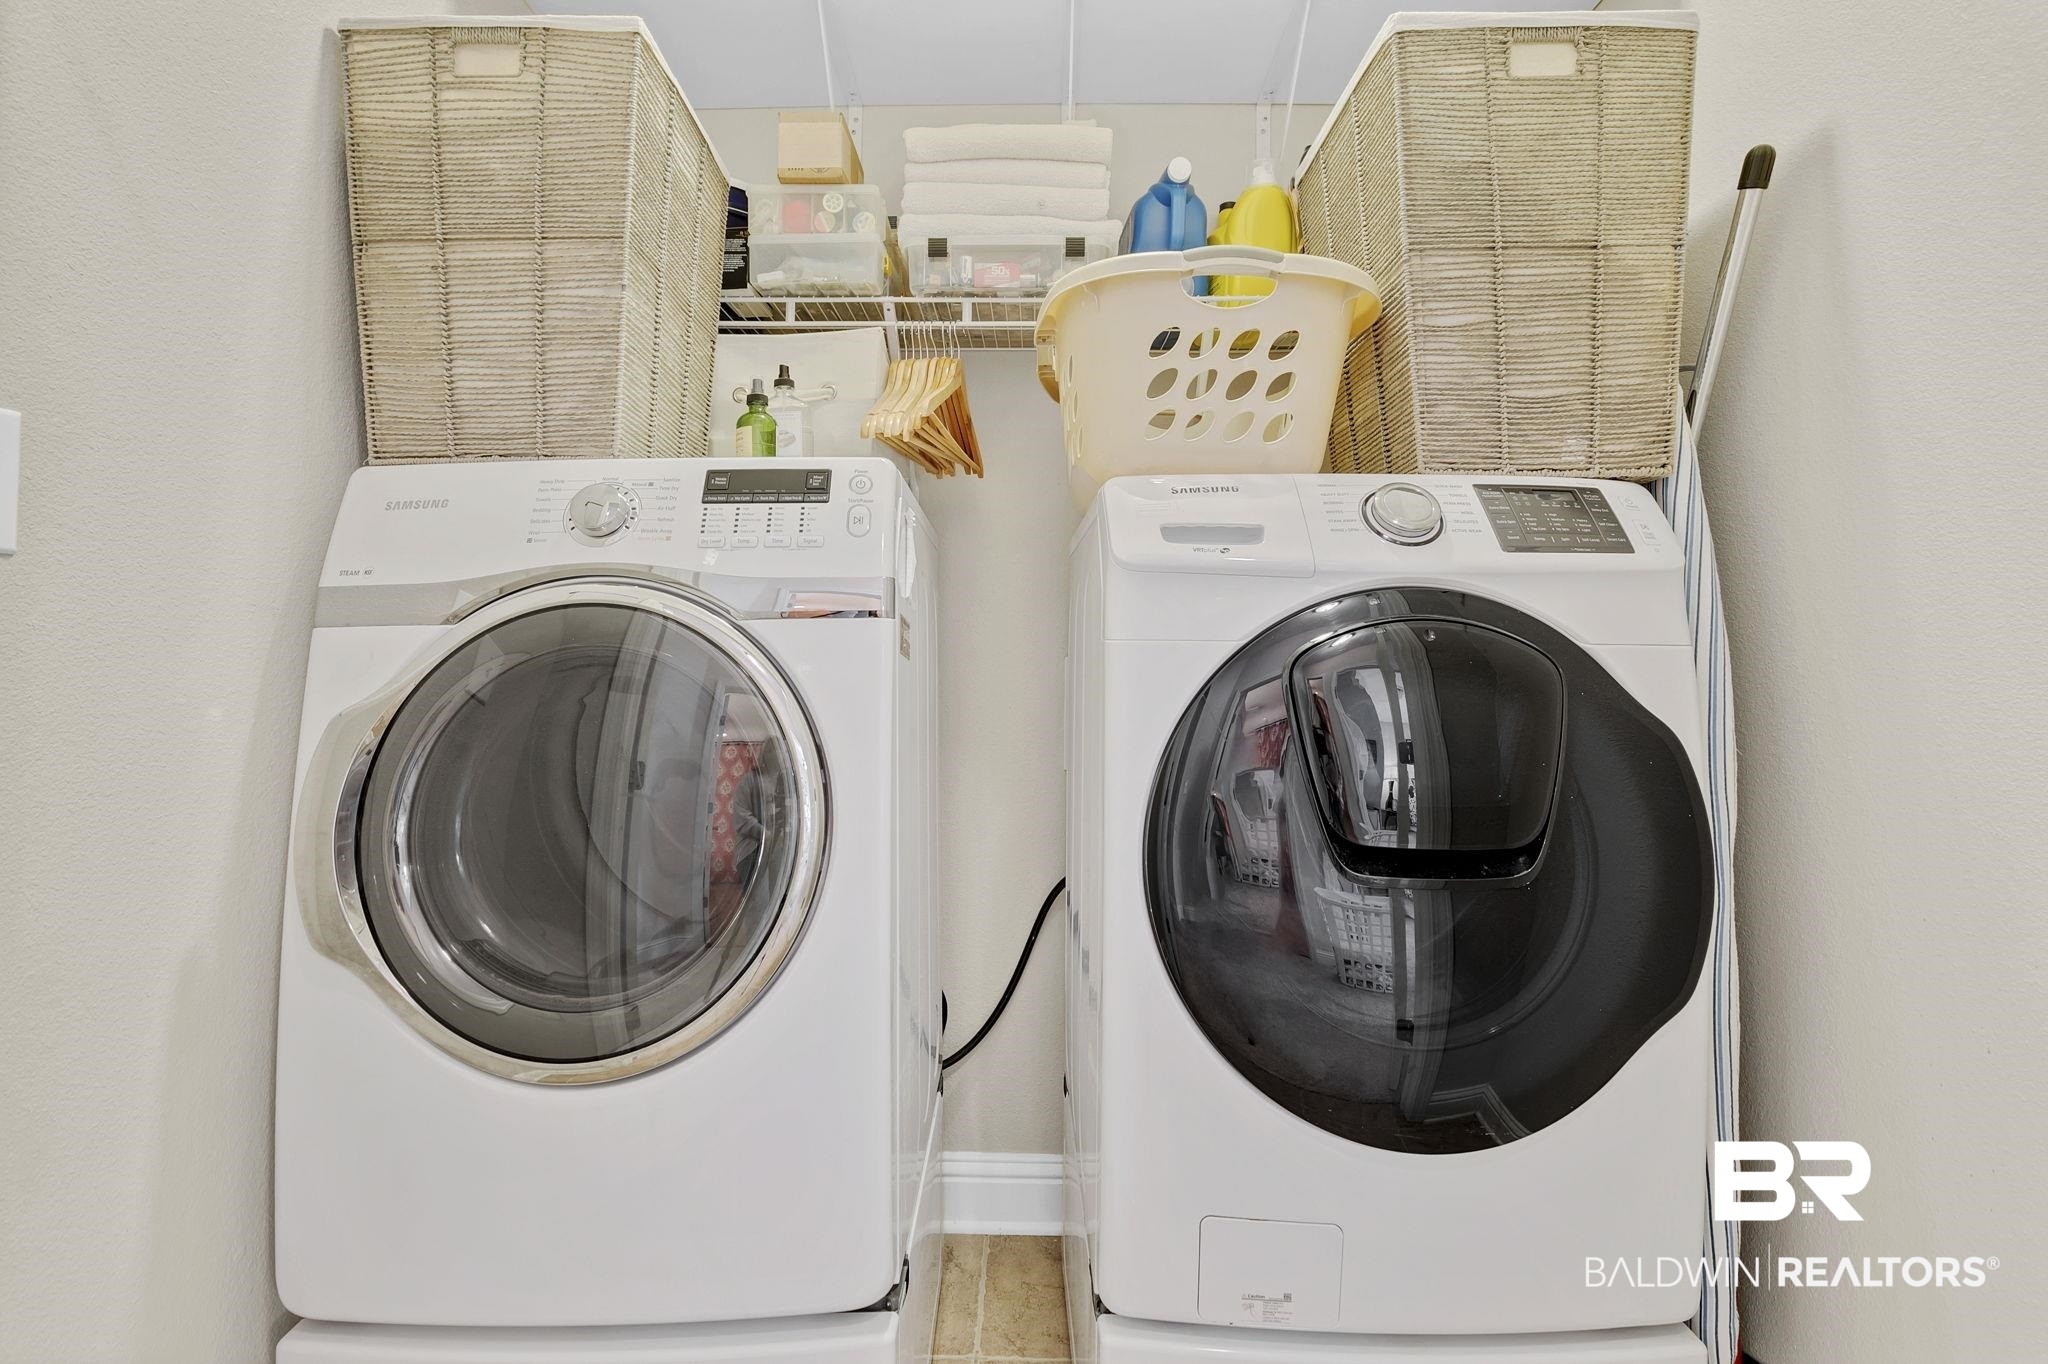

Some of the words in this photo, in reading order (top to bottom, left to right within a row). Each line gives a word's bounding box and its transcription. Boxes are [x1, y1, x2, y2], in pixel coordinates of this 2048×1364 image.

[1170, 485, 1240, 495] SAMSUNG
[384, 498, 450, 511] SAMSUNG
[338, 569, 361, 577] STEAM
